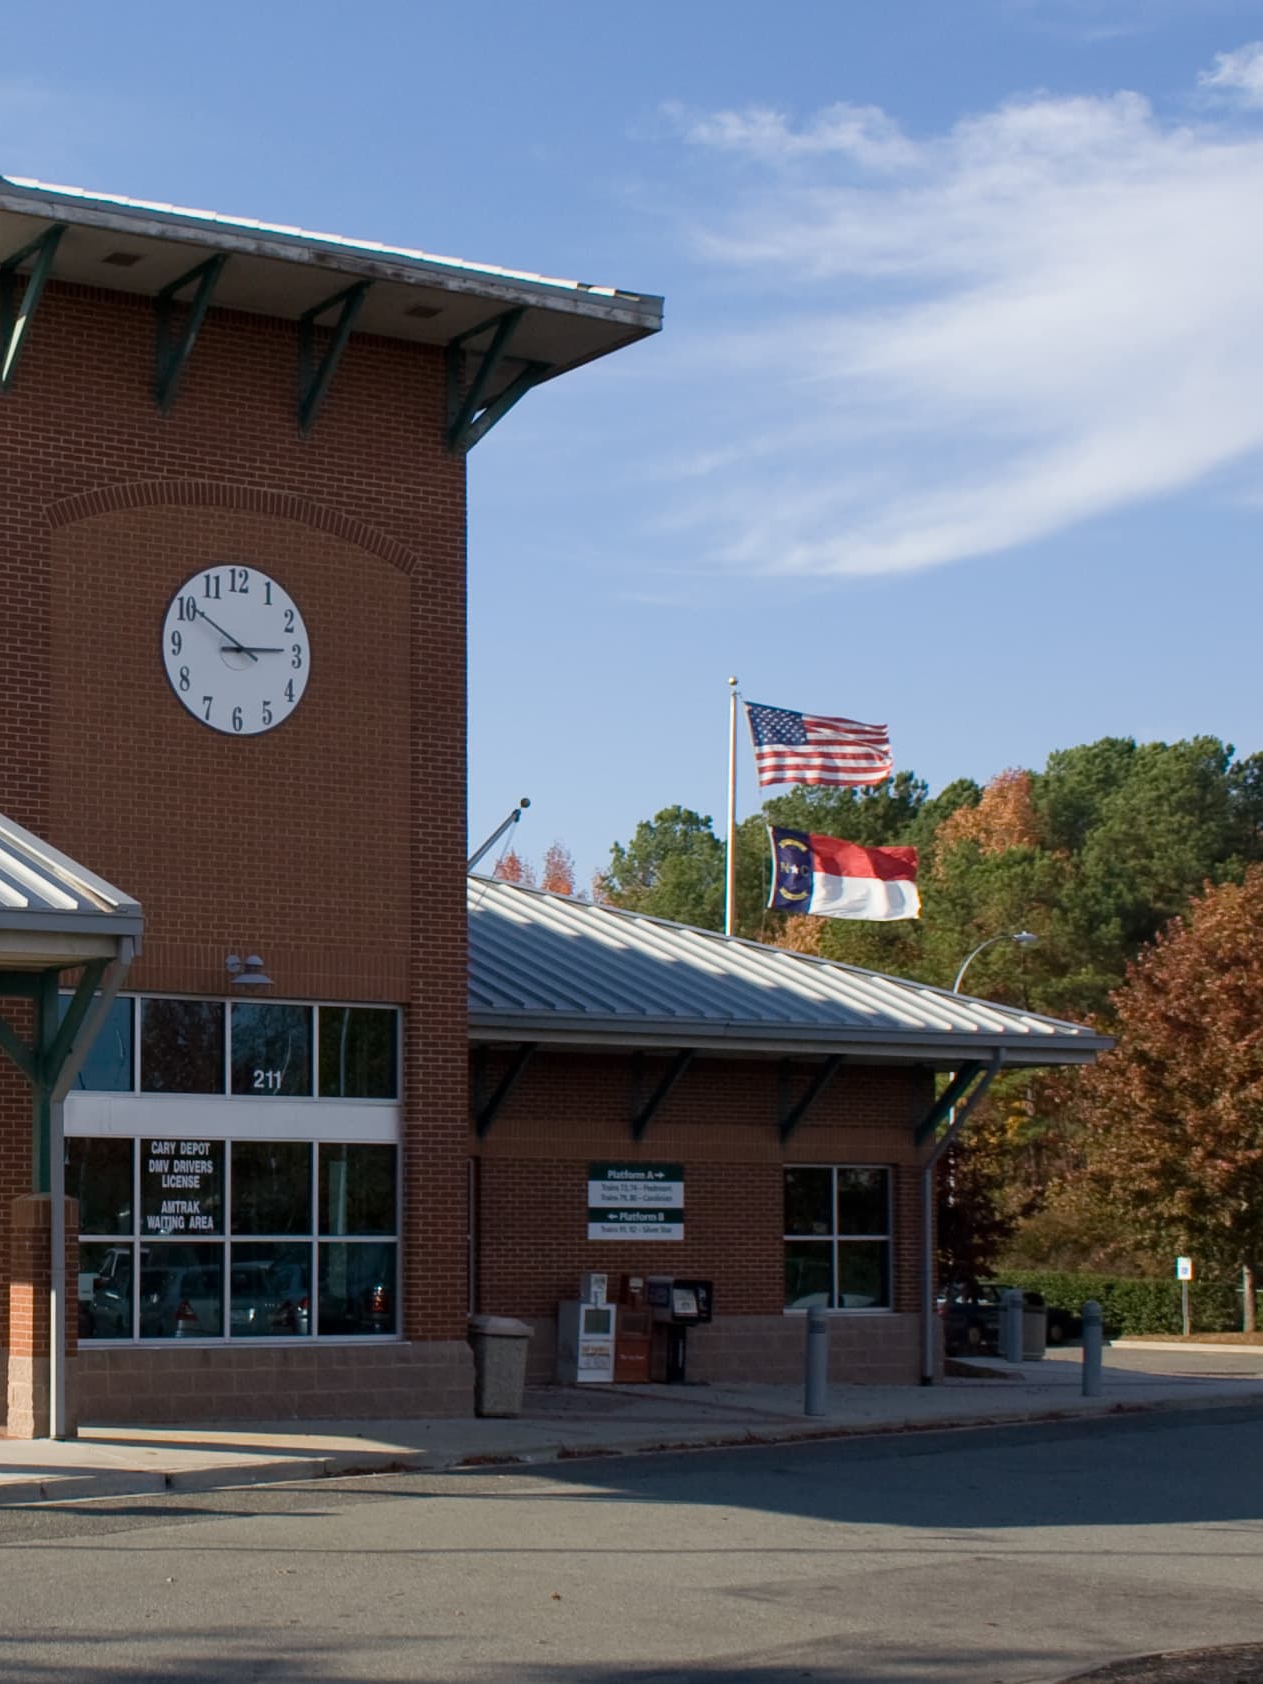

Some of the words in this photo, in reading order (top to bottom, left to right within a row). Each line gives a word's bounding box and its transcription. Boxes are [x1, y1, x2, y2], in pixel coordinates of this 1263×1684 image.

[203, 574, 222, 600] 11
[228, 568, 249, 594] 12
[264, 581, 273, 606] 1
[177, 596, 197, 622] 10
[284, 609, 294, 633] 2
[171, 630, 182, 656] 9
[291, 644, 302, 669] 3
[179, 666, 190, 691] 8
[284, 678, 295, 703] 4
[202, 696, 213, 721] 7
[232, 707, 243, 732] 6
[262, 701, 273, 725] 5
[253, 1069, 282, 1089] 211
[151, 1141, 176, 1155] CARY
[180, 1142, 210, 1156] DEPOT
[149, 1159, 170, 1173] DMV
[173, 1160, 213, 1174] DRIVERS
[607, 1169, 645, 1179] Platform
[647, 1170, 654, 1180] A
[161, 1175, 200, 1189] LICENSE
[161, 1200, 200, 1214] AMTRAK
[619, 1212, 657, 1222] Platform
[658, 1212, 665, 1222] B
[147, 1215, 185, 1229] WAITING
[189, 1216, 214, 1229] AREA
